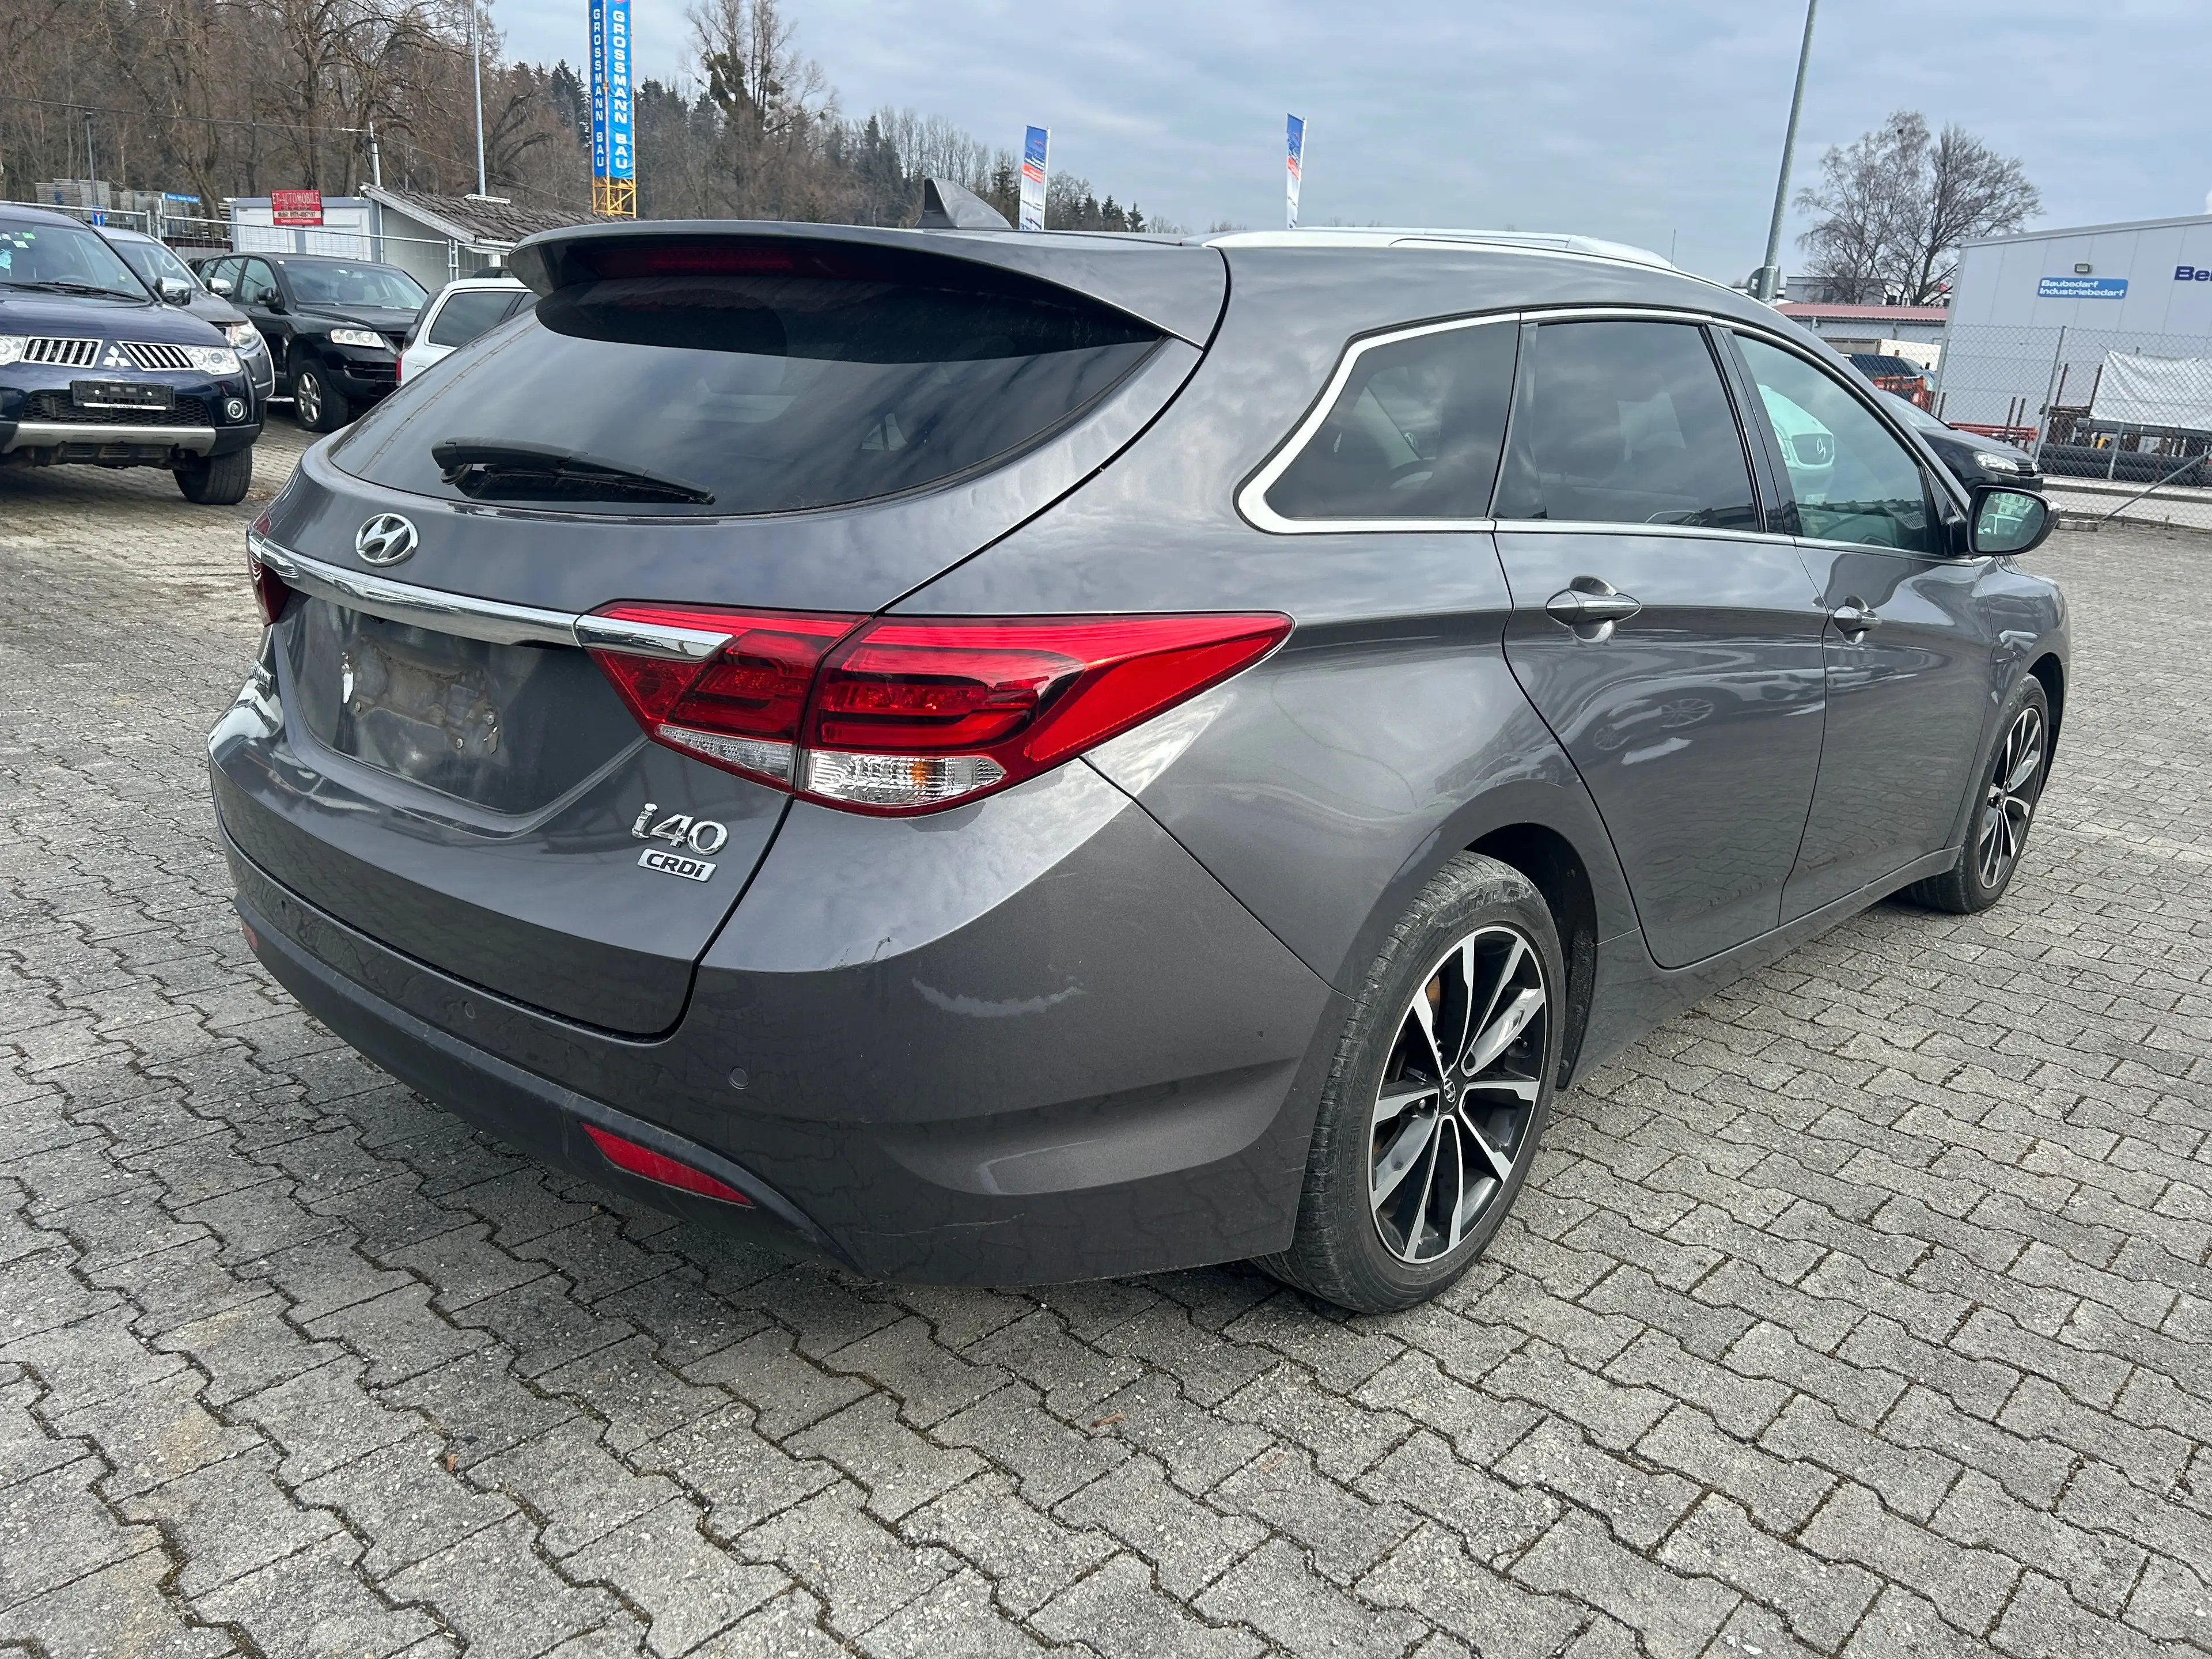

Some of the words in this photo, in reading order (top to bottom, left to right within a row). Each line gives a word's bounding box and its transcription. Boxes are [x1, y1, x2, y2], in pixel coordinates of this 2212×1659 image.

[593, 9, 603, 121] GROSSMANN
[613, 10, 627, 123] GROSSMANN
[596, 132, 604, 167] BAU
[615, 133, 628, 169] BAU
[2041, 279, 2099, 288] Baubedarf
[2175, 266, 2212, 281] Be
[2039, 287, 2124, 297] Industriebedarf
[631, 802, 729, 855] i40
[646, 853, 706, 878] CRDi
